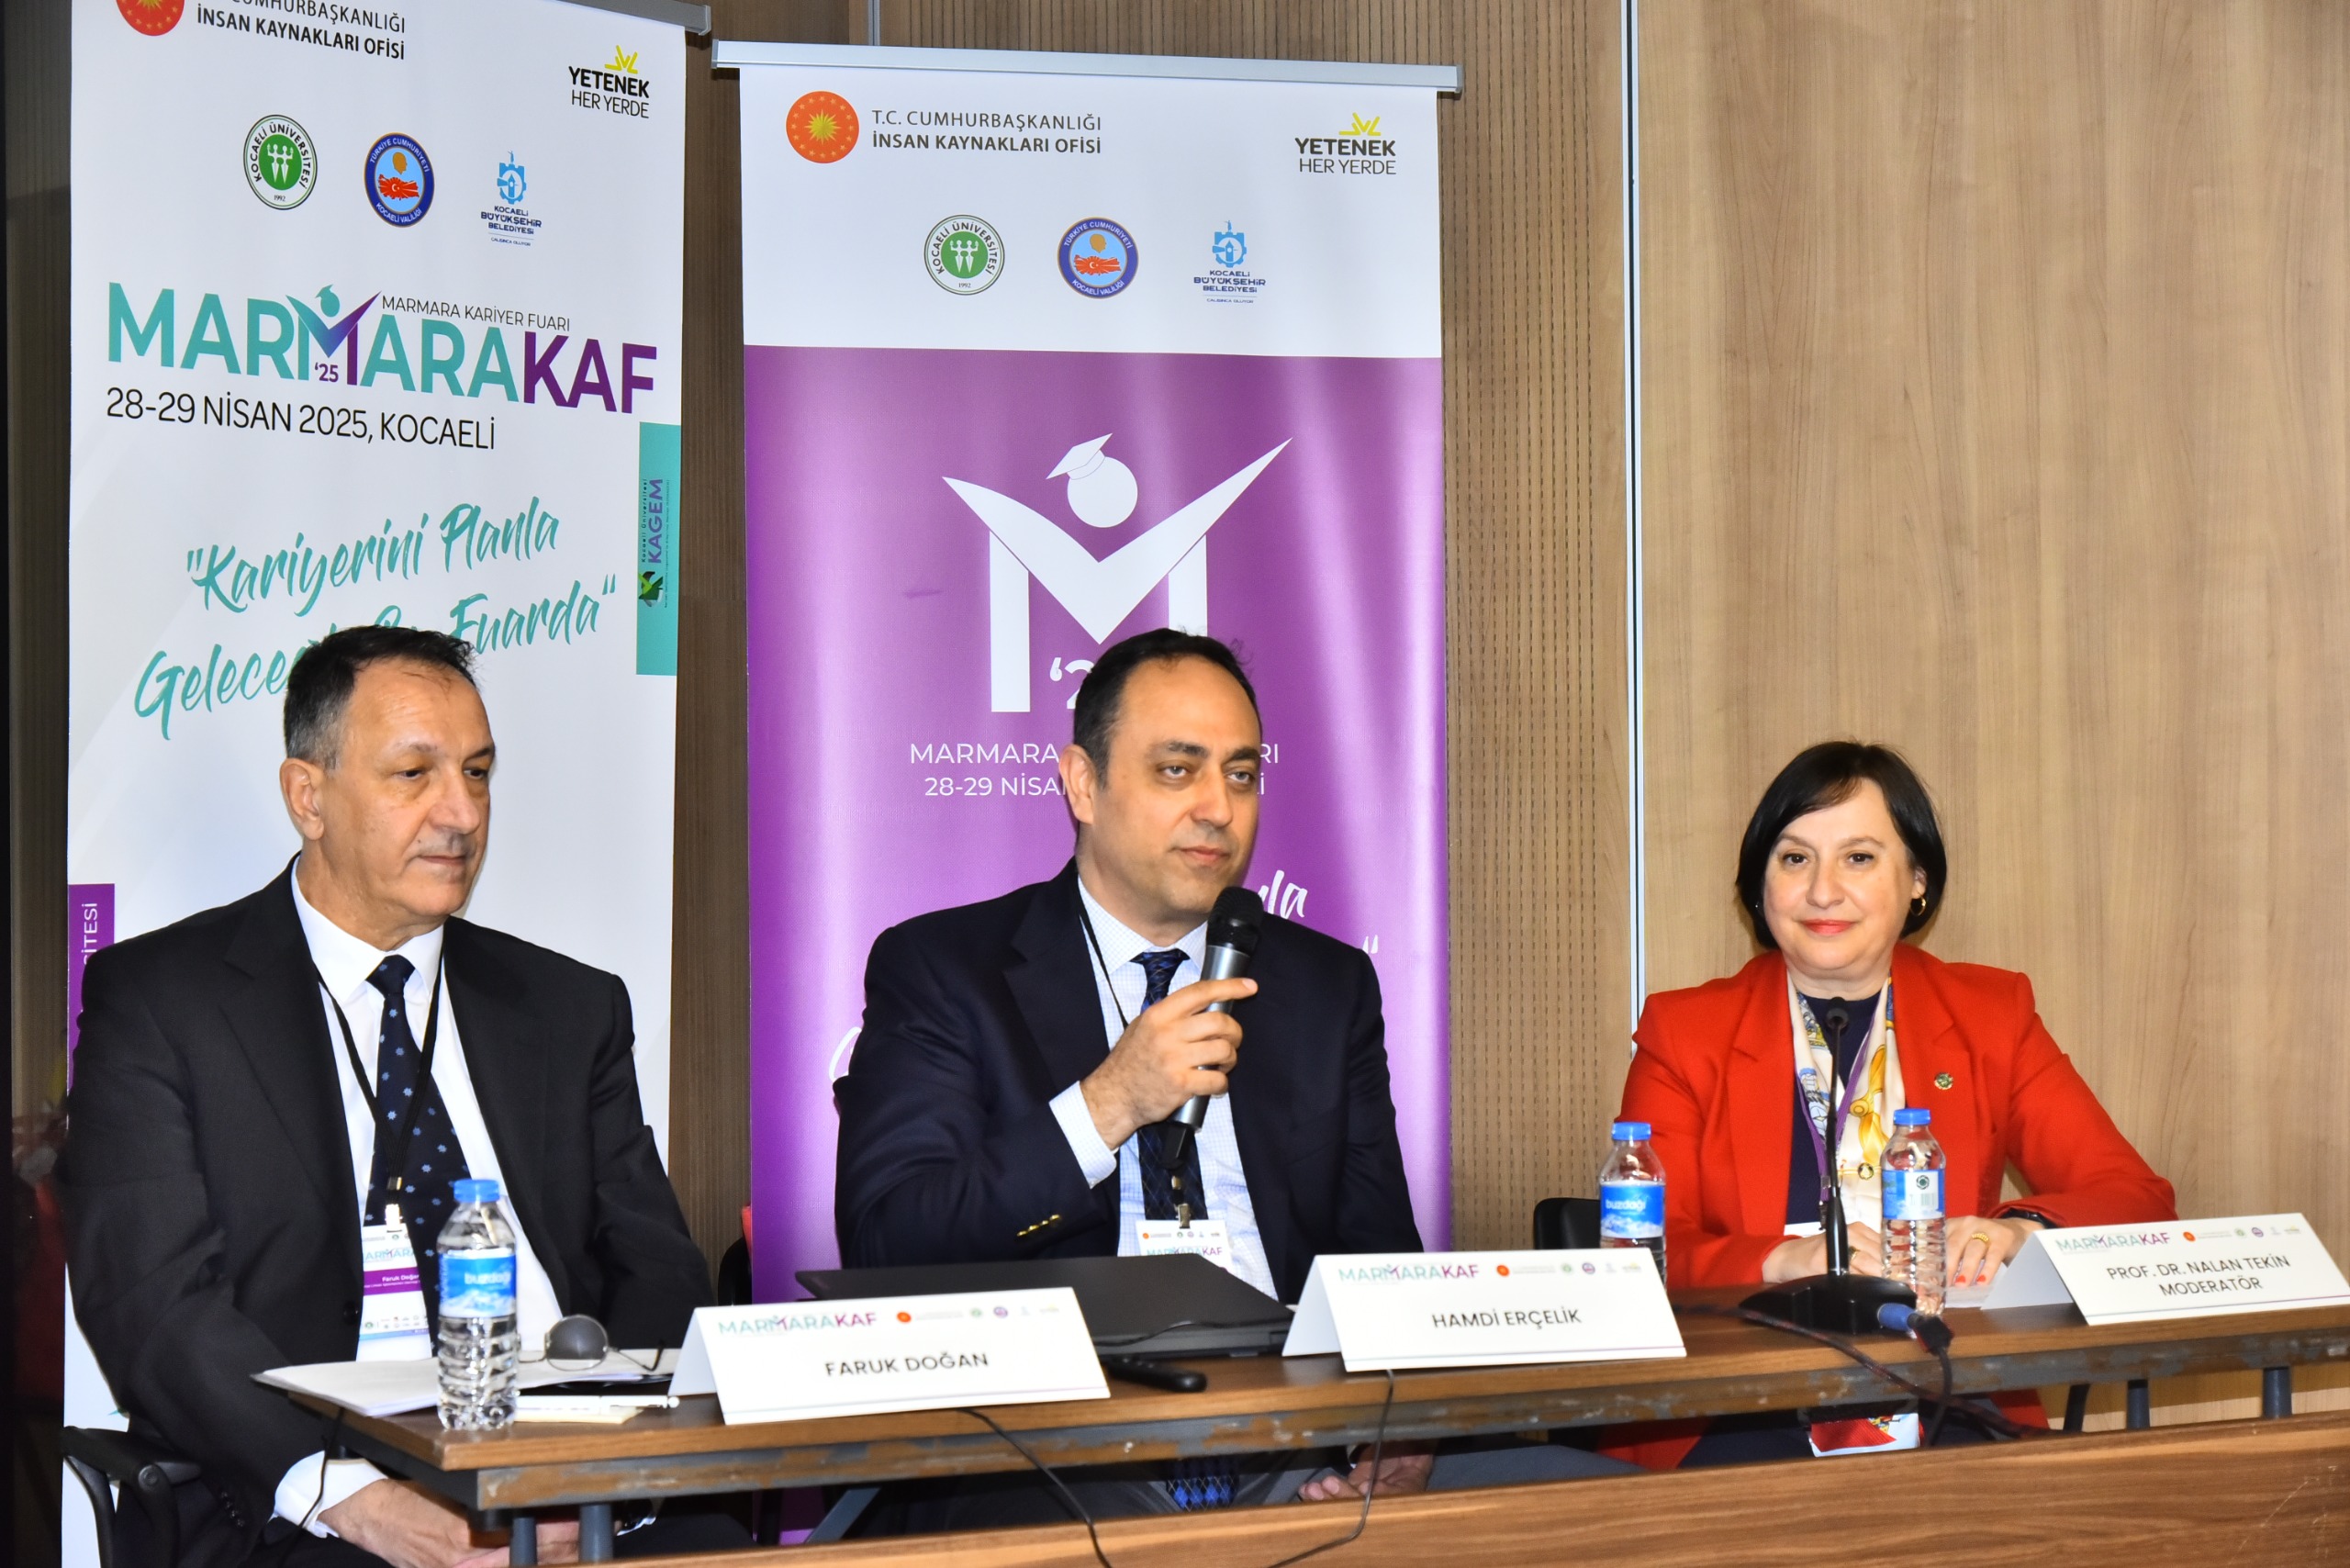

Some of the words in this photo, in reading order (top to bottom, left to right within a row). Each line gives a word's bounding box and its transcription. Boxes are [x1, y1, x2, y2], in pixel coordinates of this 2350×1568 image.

[197, 4, 251, 32] İNSAN
[255, 17, 359, 51] KAYNAKLARI
[364, 38, 405, 60] OFİSİ
[568, 65, 650, 98] YETENEK
[571, 89, 600, 110] HER
[603, 95, 650, 118] YERDE
[871, 110, 901, 125] T.C.
[906, 110, 1102, 132] CUMHURBAŞKANLIĞI
[872, 130, 929, 149] İNSAN
[935, 135, 1049, 152] KAYNAKLARI
[1055, 136, 1102, 154] OFİSİ
[1294, 137, 1396, 157] YETENEK
[250, 126, 268, 183] KOCAELİ
[269, 121, 312, 190] ÜNİVERSİTESİ
[369, 138, 392, 163] TÜRKİYE
[392, 137, 431, 173] CUMHURİYETİ
[1299, 158, 1335, 174] HER
[1337, 159, 1397, 175] YERDE
[274, 194, 286, 202] 1992
[375, 202, 399, 223] KOCAELİ
[480, 211, 543, 228] BÜYÜKŞEHİR
[494, 205, 529, 217] KOCAELİ
[487, 221, 534, 235] BELEDİYESİ
[1063, 223, 1089, 247] TÜRKİYE
[1089, 221, 1134, 249] CUMHURİYETİ
[931, 226, 950, 274] KOCAELİ
[951, 220, 999, 276] ÜNİVERSİTESİ
[1193, 276, 1267, 286] BÜYÜKŞEHİR
[1209, 269, 1250, 277] KOCAELİ
[1072, 279, 1100, 296] KOCAELİ
[1203, 285, 1258, 293] BELEDİYESİ
[382, 295, 460, 319] MARMARA
[464, 305, 524, 327] KARİYER
[528, 313, 570, 331] FUARI
[108, 282, 658, 414] MARMARAKAF
[106, 387, 196, 424] 28-29
[204, 391, 292, 433] NİSAN
[299, 404, 374, 444] 2025,
[380, 411, 495, 450] KOCAELİ
[647, 478, 664, 564] KAGEM
[186, 512, 429, 617] "Kariyerini
[439, 496, 559, 572] Planla
[134, 622, 336, 741] Gelece
[911, 743, 1059, 764] MARMARA
[924, 777, 992, 797] 28-29
[1002, 773, 1067, 796] NİSA
[2054, 1232, 2171, 1253] MARMARAKAF
[1337, 1263, 1480, 1282] MARMARAKAF
[2107, 1266, 2156, 1281] PROF.
[2156, 1262, 2186, 1277] DR.
[2187, 1259, 2243, 1273] NALAN
[2243, 1252, 2291, 1270] TEKİN
[2158, 1275, 2264, 1297] MODERATÖR
[718, 1312, 878, 1334] MARMARAKAF
[1431, 1308, 1500, 1328] HAMDİ
[1505, 1305, 1582, 1330] ERÇELİK
[824, 1359, 899, 1377] FARUK
[904, 1352, 990, 1372] DOĞAN
